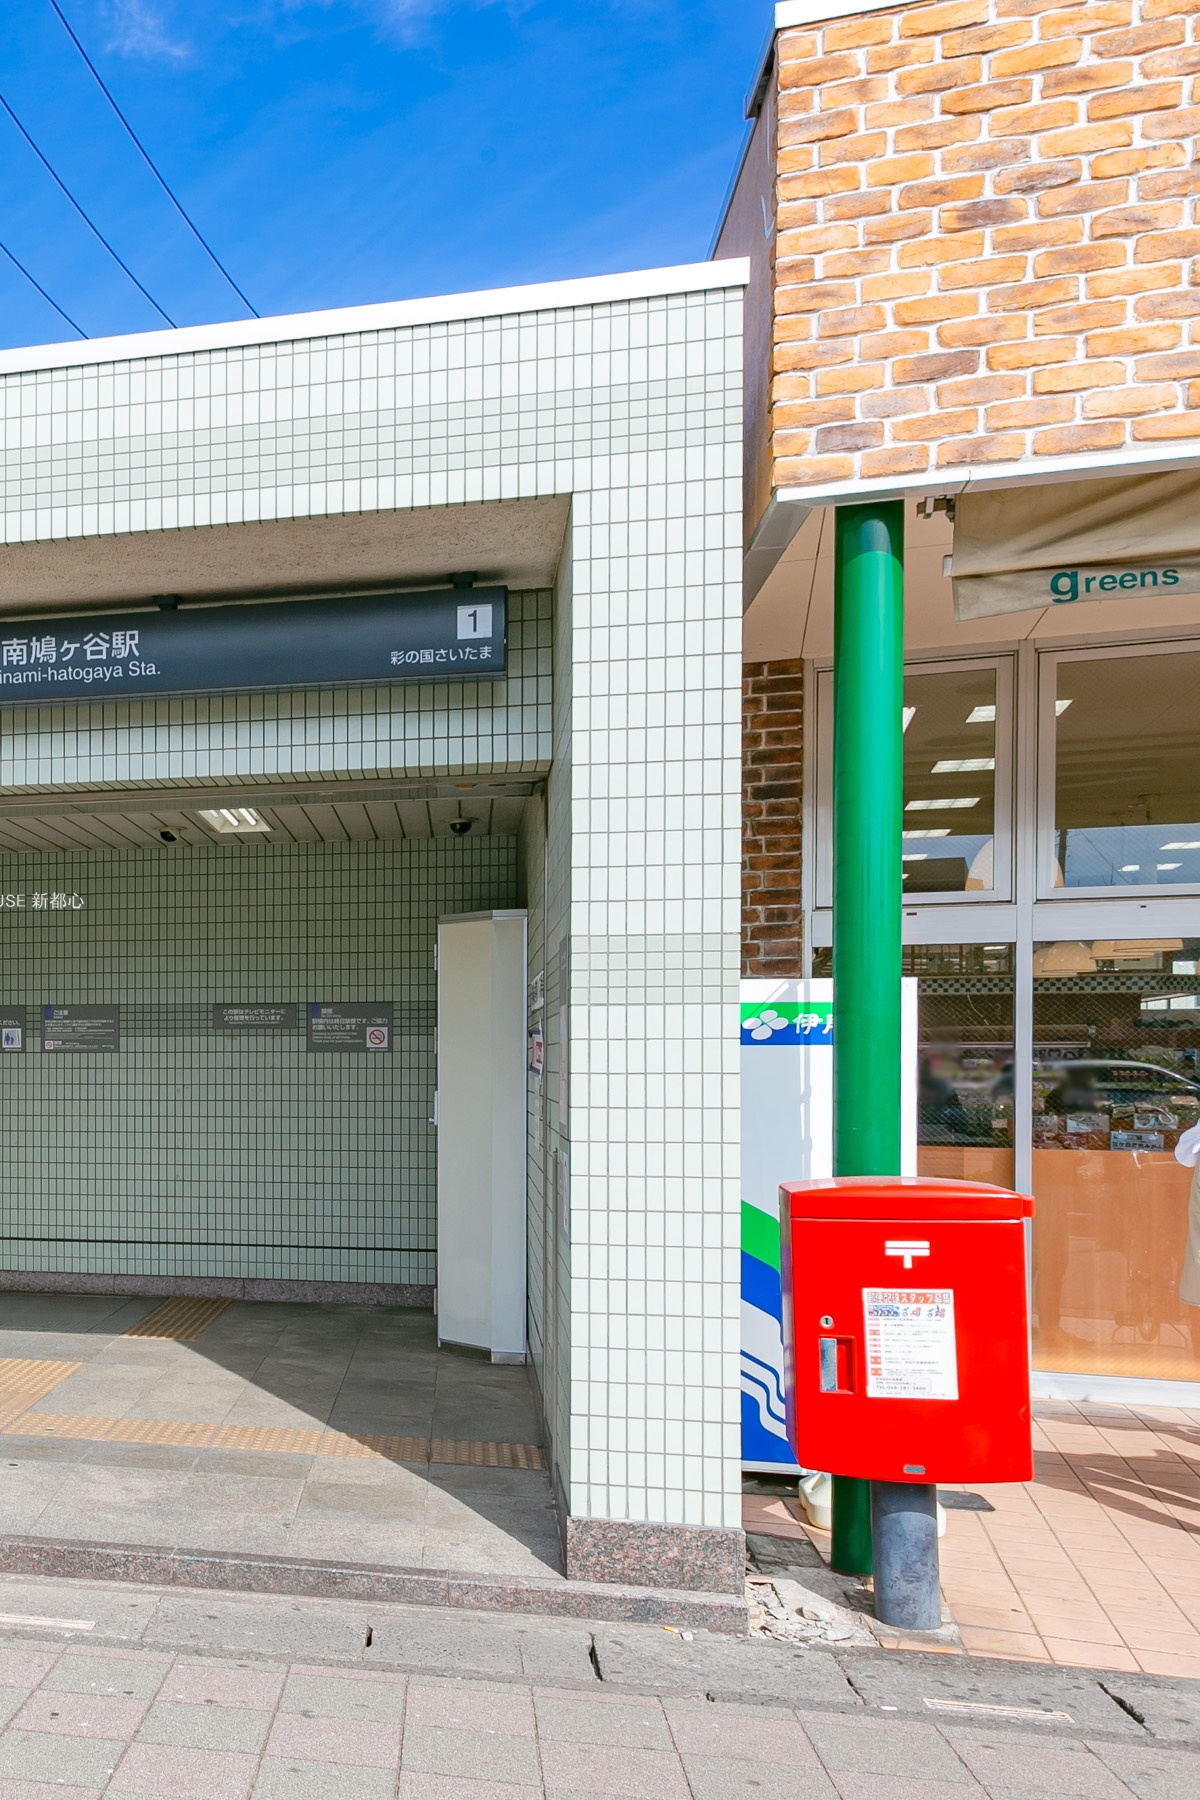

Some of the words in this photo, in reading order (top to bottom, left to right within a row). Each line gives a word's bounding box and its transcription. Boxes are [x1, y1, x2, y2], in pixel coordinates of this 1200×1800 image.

[1050, 568, 1180, 603] greens
[467, 609, 478, 633] 1
[1, 630, 141, 666] 南鳩ヶ谷駅
[390, 646, 493, 665] 彩の国さいたま
[128, 660, 161, 676] Sta.
